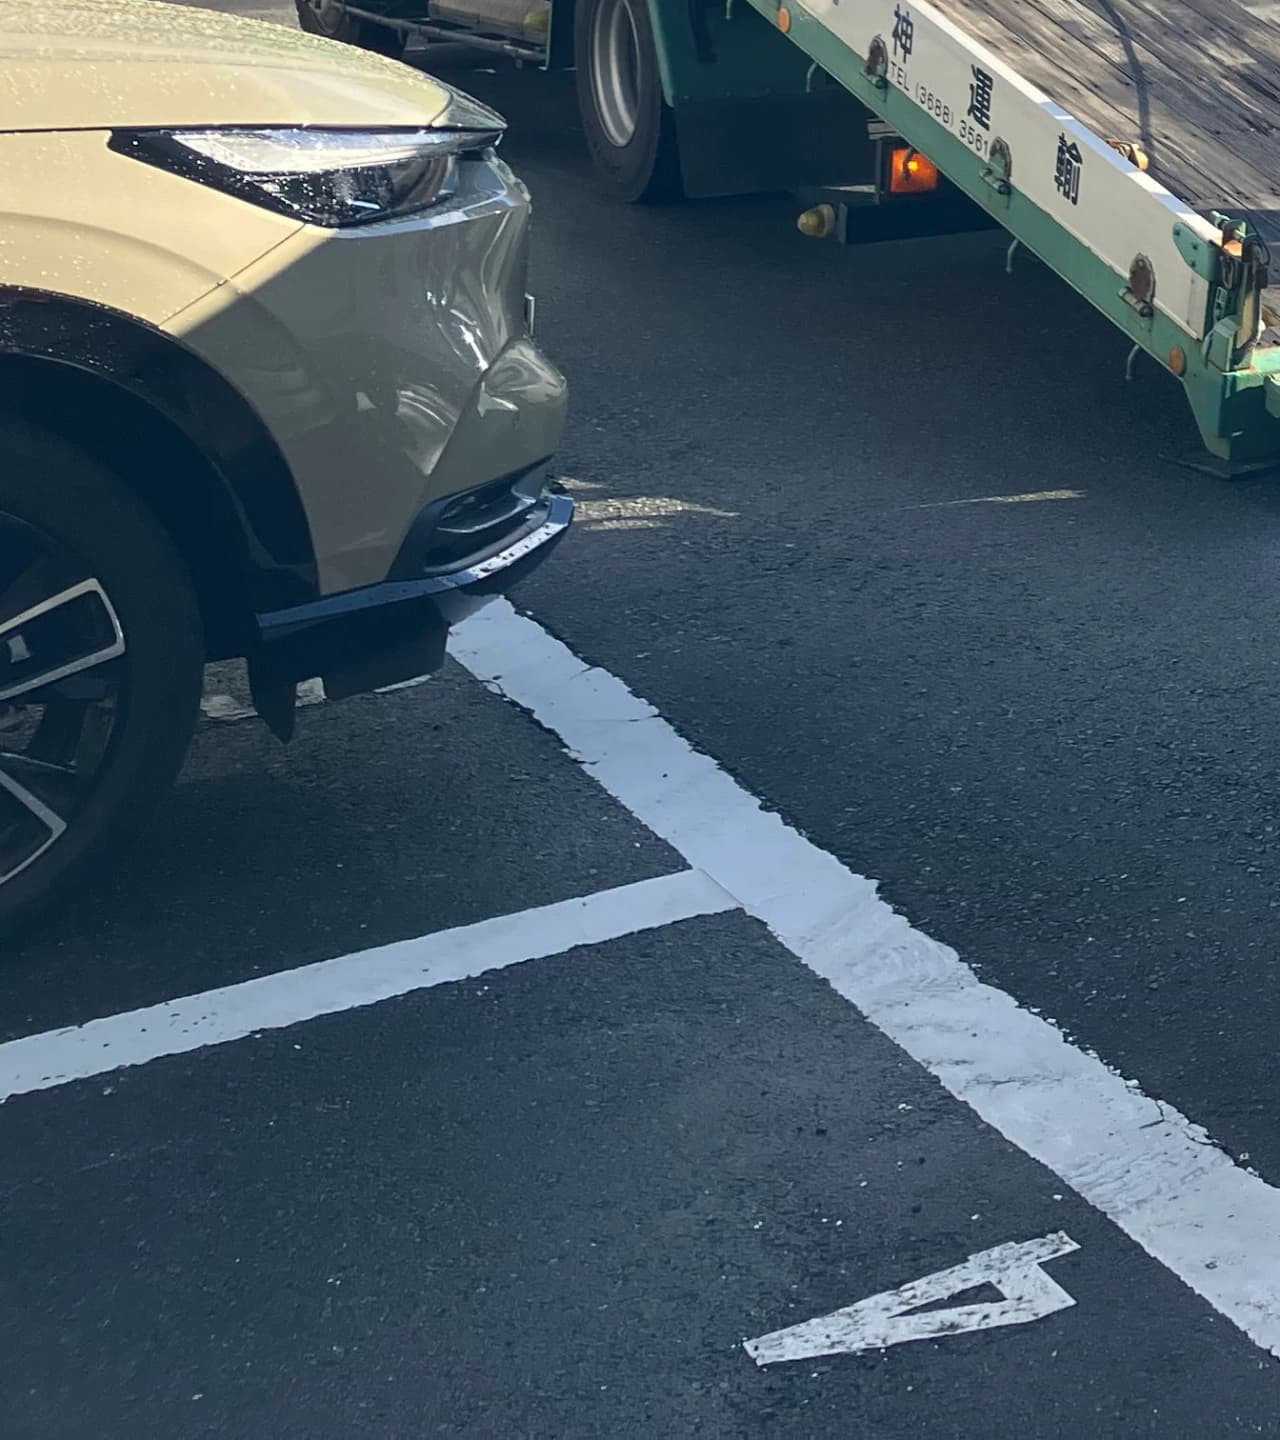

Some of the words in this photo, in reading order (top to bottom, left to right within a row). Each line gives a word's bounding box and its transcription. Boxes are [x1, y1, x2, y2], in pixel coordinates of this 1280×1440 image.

[890, 60, 909, 92] TEL
[915, 82, 954, 128] (3688)
[960, 119, 989, 157] 3561
